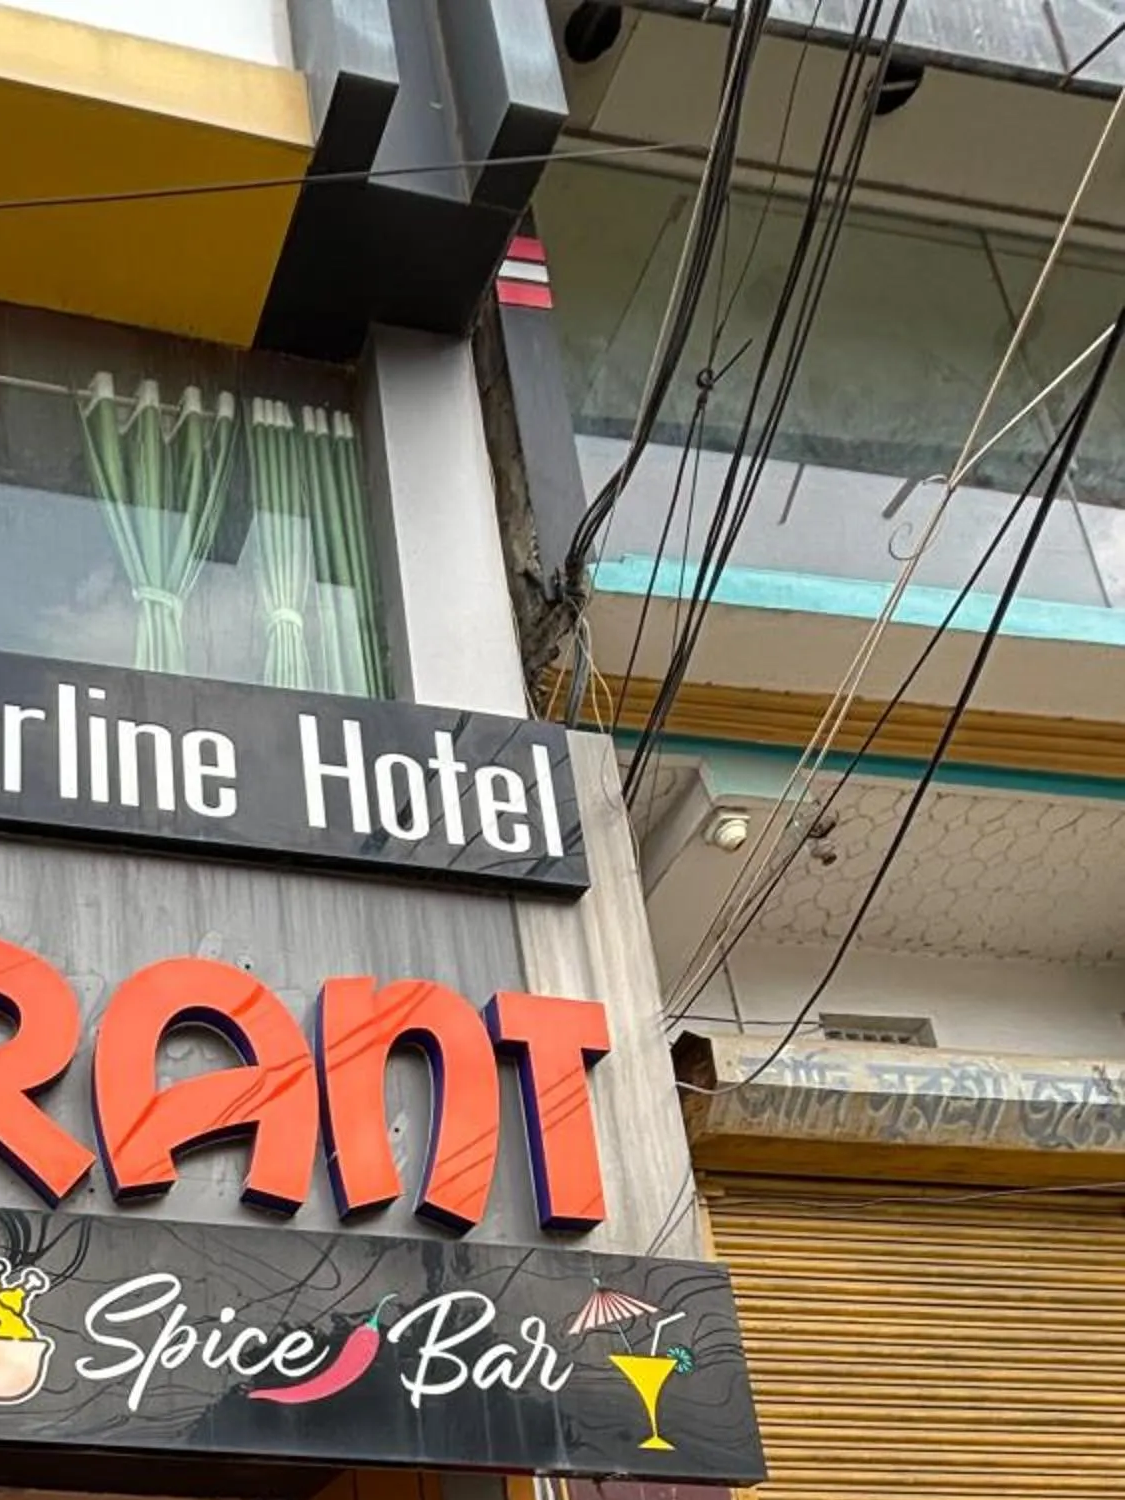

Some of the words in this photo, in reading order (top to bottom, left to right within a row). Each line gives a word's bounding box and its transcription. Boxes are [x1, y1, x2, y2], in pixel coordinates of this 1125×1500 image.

[299, 714, 565, 858] Hotel
[75, 1272, 330, 1412] Spice
[387, 1290, 575, 1409] Bar
